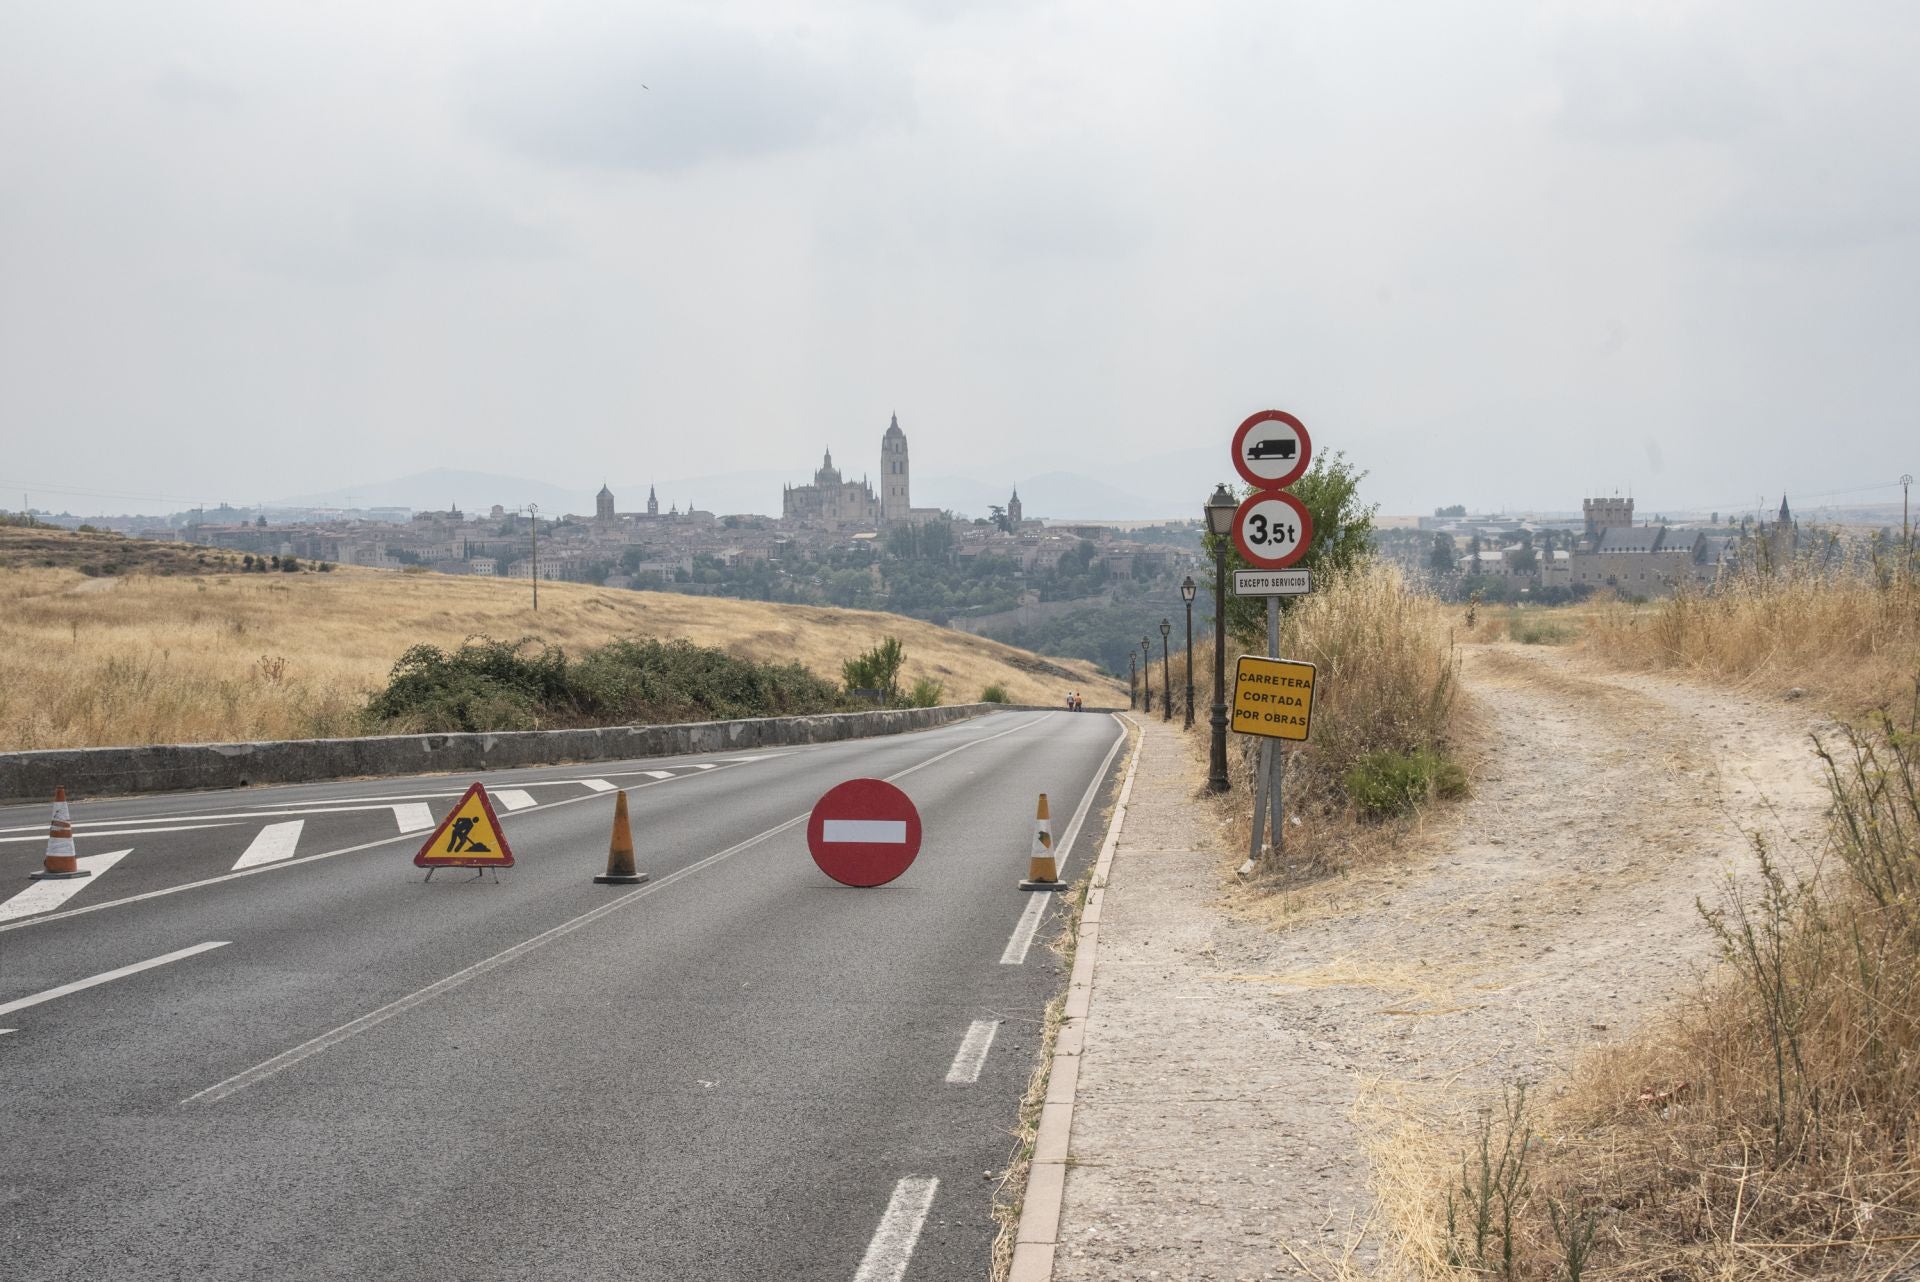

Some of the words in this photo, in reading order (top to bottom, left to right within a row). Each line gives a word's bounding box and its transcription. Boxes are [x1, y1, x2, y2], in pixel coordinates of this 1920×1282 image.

[1240, 579, 1269, 588] EXCEPTO
[1271, 577, 1306, 587] SERVICIOS
[1239, 672, 1311, 689] CARRETERA
[1243, 691, 1302, 707] CORTADA
[1235, 709, 1259, 720] POR
[1264, 713, 1306, 726] OBRAS
